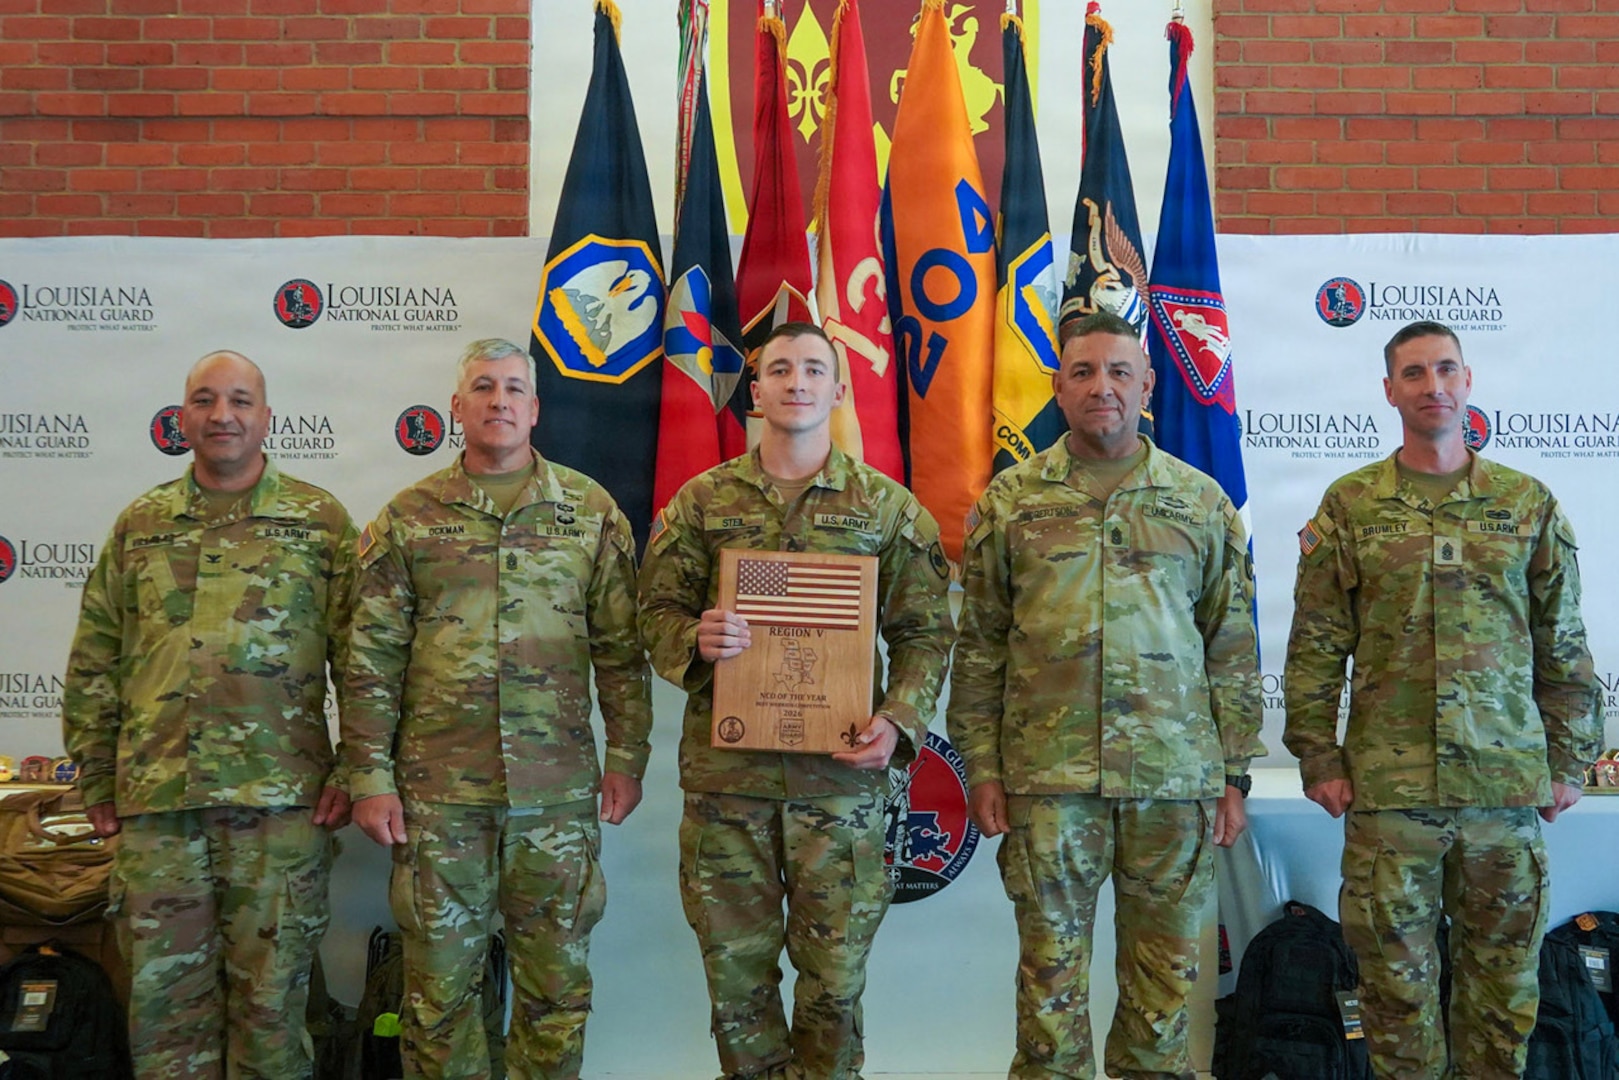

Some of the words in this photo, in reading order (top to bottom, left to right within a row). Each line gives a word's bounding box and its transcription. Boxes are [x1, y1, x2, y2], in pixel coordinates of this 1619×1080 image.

[22, 284, 153, 309] LOUISIANA
[327, 283, 458, 309] LOUISIANA
[1369, 282, 1502, 308] LOUISIANA
[22, 309, 96, 321] NATIONAL
[100, 309, 154, 321] GUARD
[327, 309, 400, 321] NATIONAL
[404, 309, 458, 322] GUARD
[1369, 309, 1444, 321] NATIONAL
[1448, 309, 1503, 321] GUARD
[0, 413, 89, 434] UISIANA
[1245, 410, 1378, 435] LOUISIANA
[35, 436, 89, 448] GUARD
[281, 437, 335, 450] GUARD
[1246, 436, 1321, 448] NATIONAL
[1325, 436, 1380, 448] GUARD
[1495, 436, 1570, 448] NATIONAL
[842, 517, 869, 530] ARMY
[1362, 523, 1408, 537] BRUMLEY
[1494, 524, 1520, 534] ARMY
[563, 529, 586, 538] ARMY
[21, 540, 94, 565] LOUISI
[769, 627, 811, 637] REGION
[816, 629, 824, 638] V
[33, 696, 64, 708] GUA
[806, 694, 827, 702] YEAR
[948, 847, 971, 878] ALWAYS
